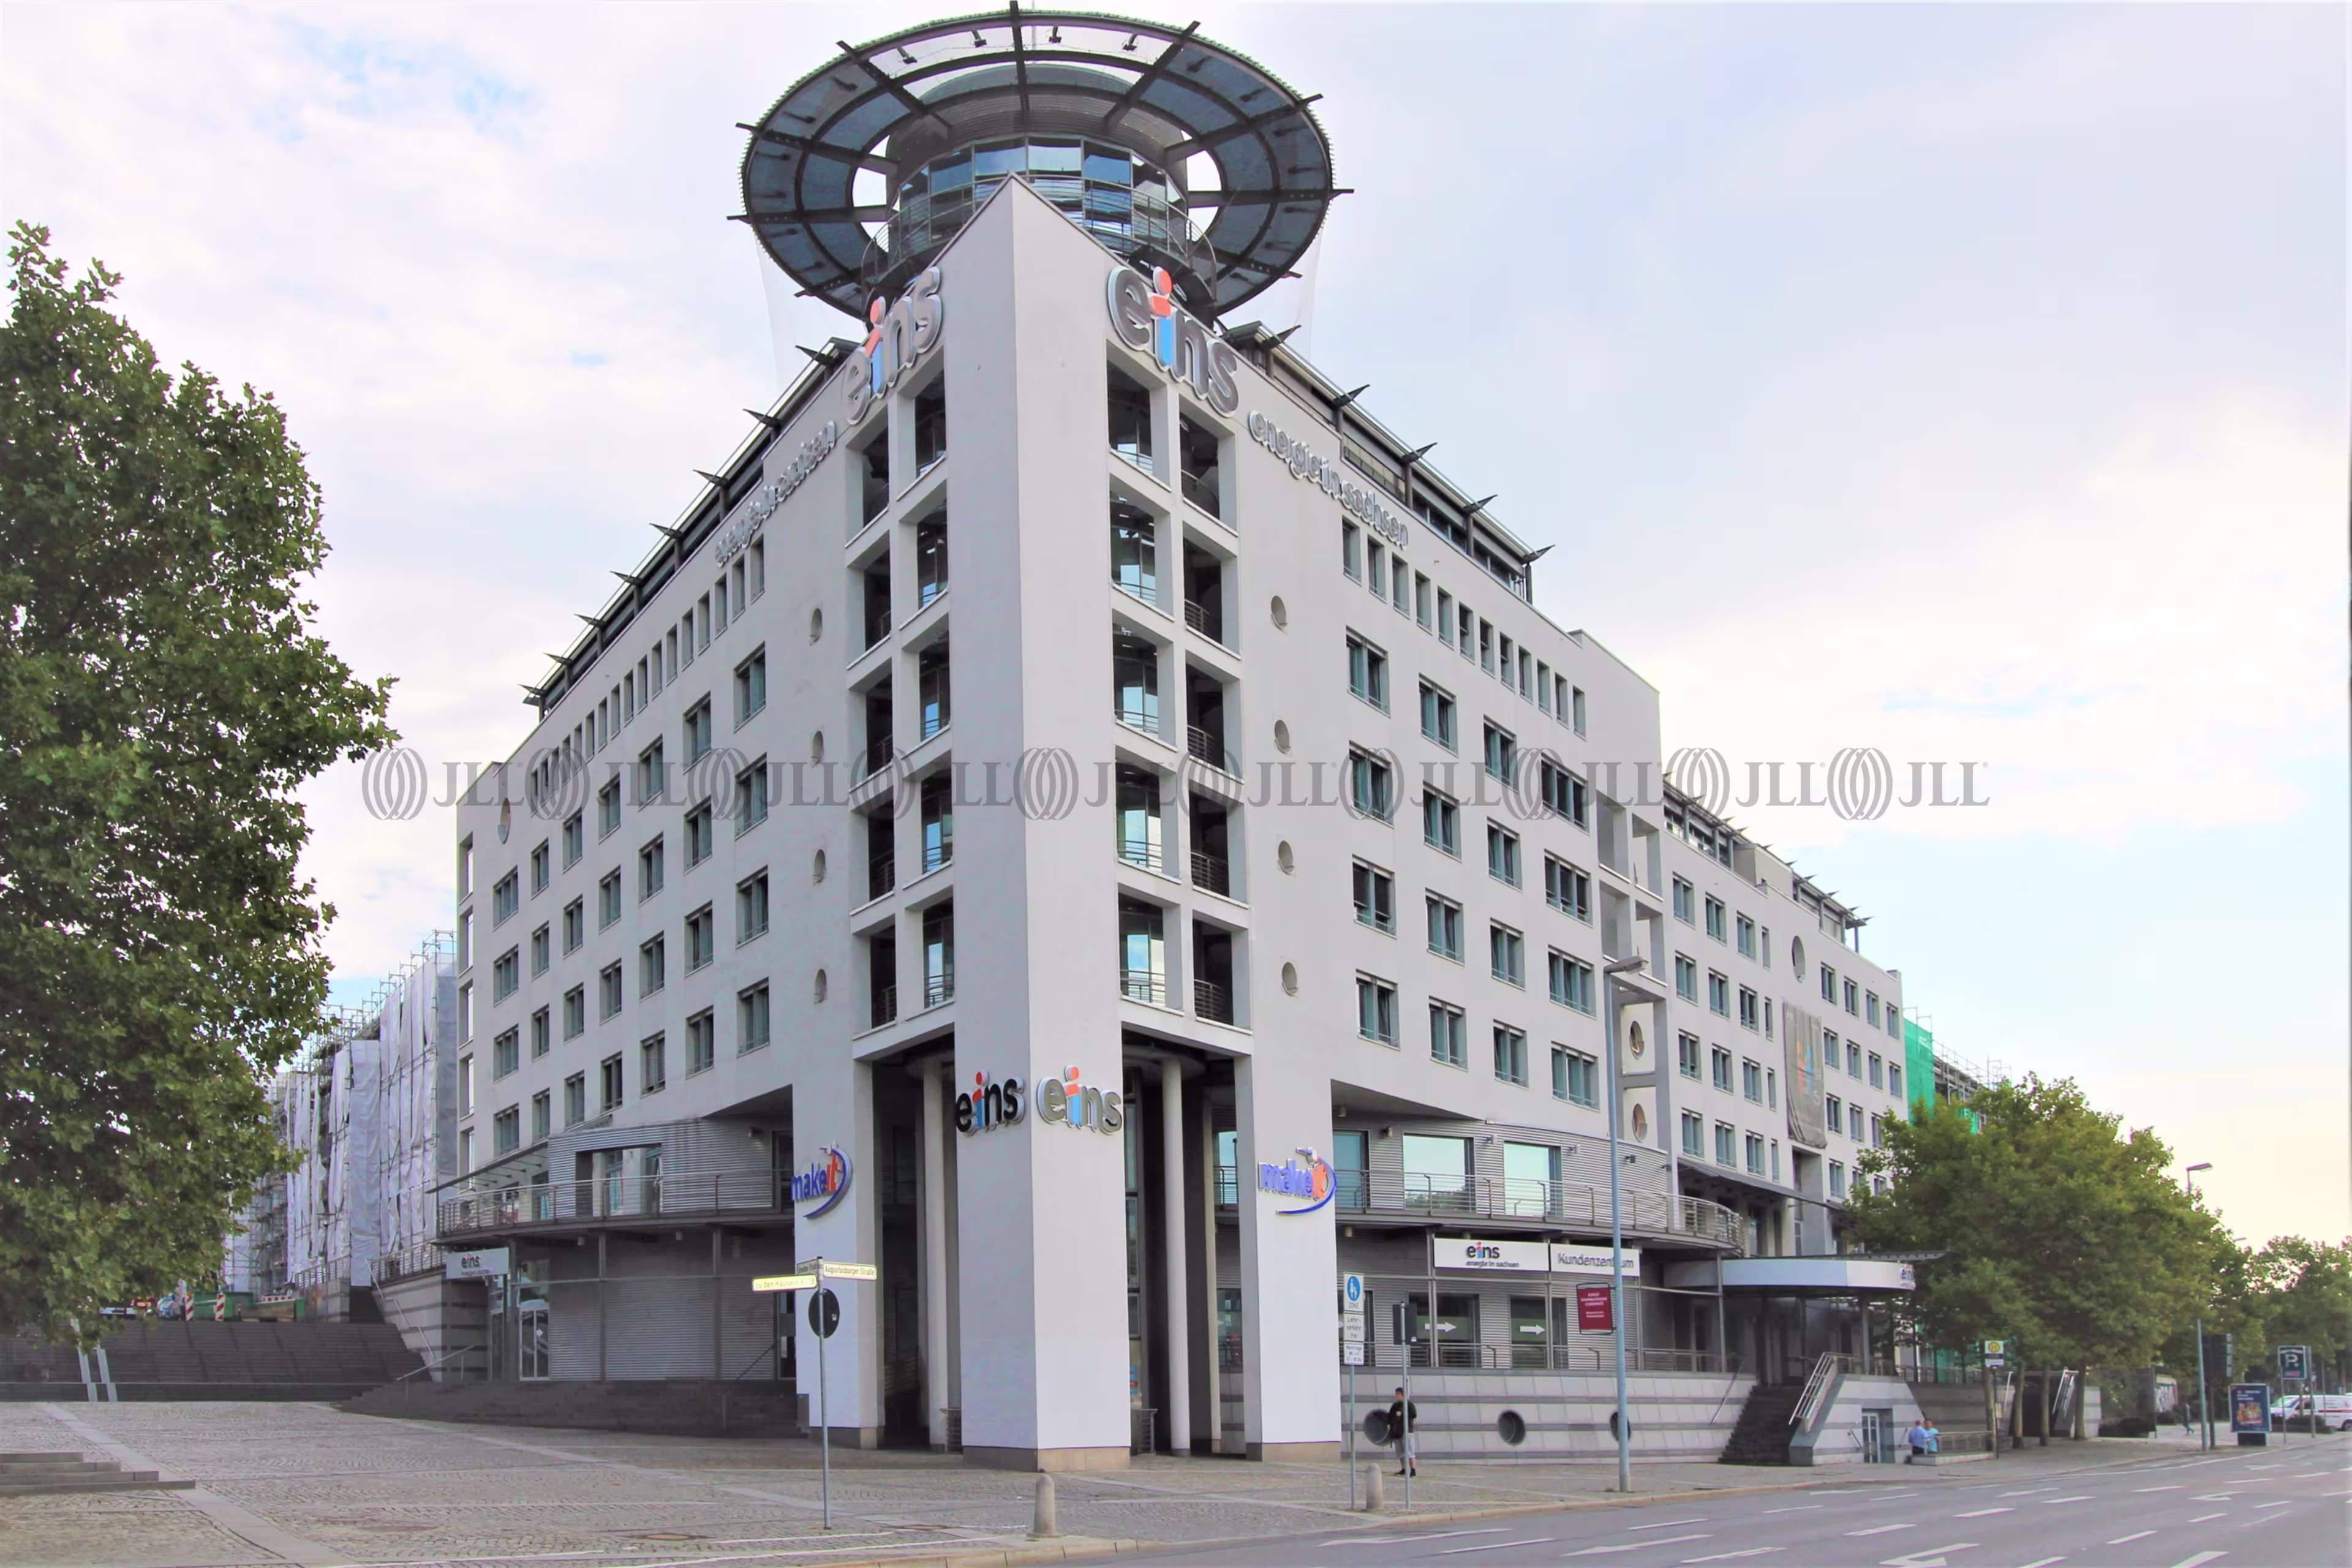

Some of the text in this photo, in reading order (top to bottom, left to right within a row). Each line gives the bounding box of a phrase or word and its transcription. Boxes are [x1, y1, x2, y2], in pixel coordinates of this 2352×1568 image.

[842, 266, 943, 424] eins
[1107, 265, 1238, 417] eins
[1249, 410, 1408, 550] energie in sachsen
[955, 1070, 1025, 1135] eins
[1037, 1065, 1122, 1135] eins
[461, 1253, 480, 1268] eins
[825, 1265, 859, 1276] Augustusburger
[860, 1267, 875, 1276] Straße
[1466, 1242, 1500, 1259] eins
